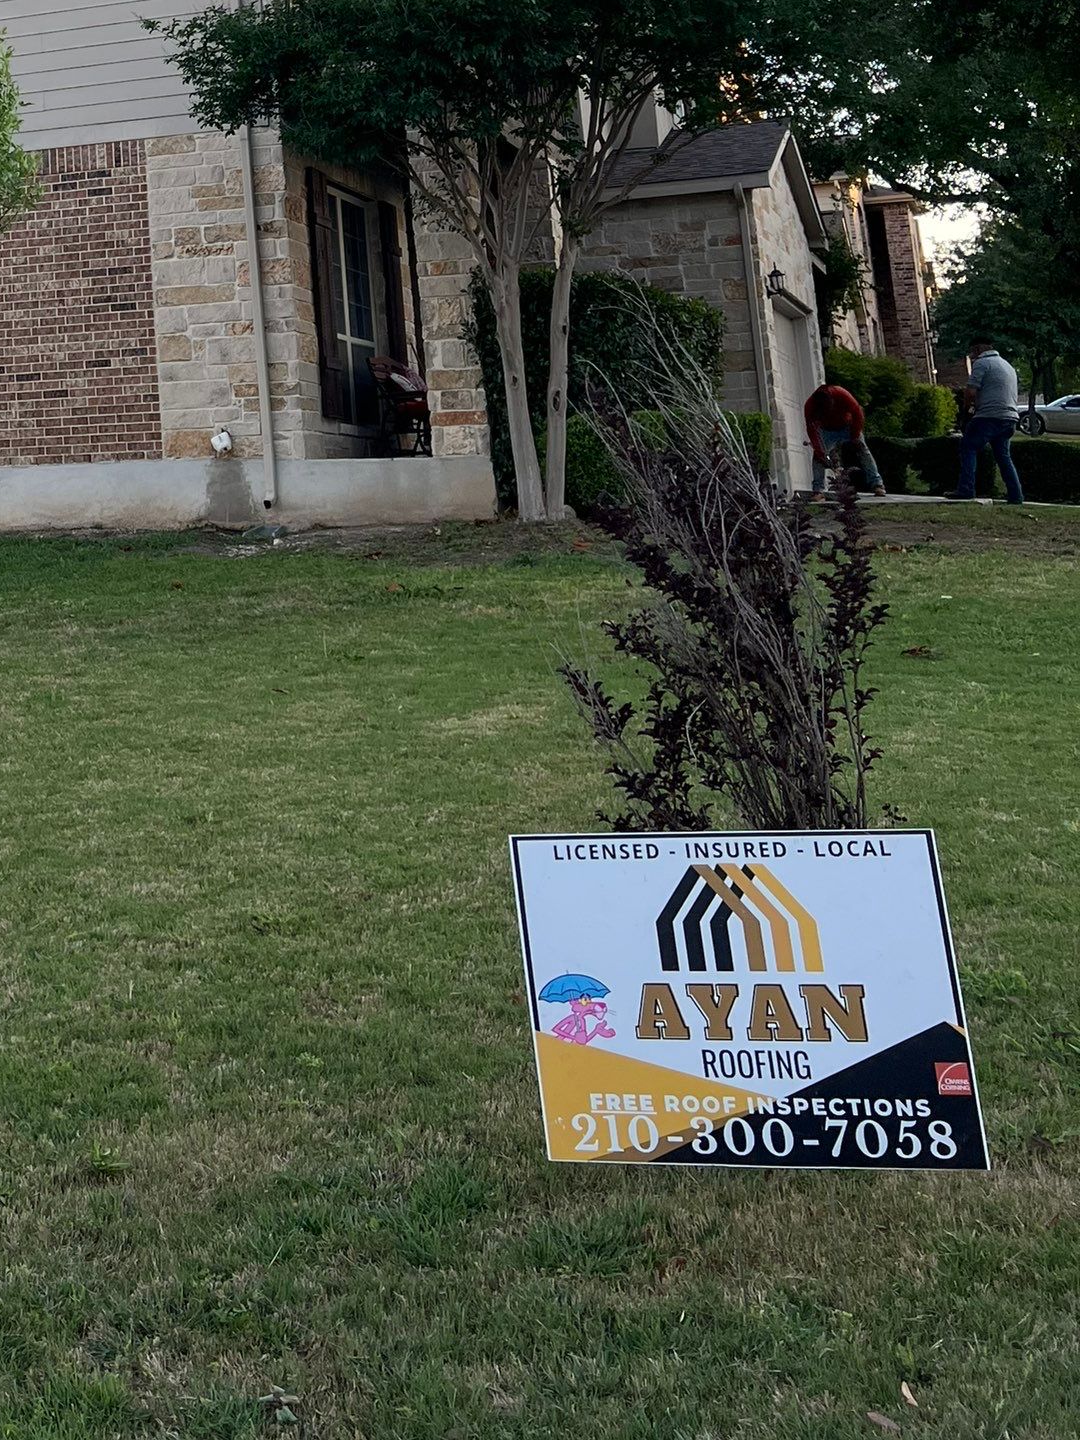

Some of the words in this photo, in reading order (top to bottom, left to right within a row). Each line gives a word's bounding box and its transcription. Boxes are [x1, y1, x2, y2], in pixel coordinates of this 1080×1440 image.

[552, 843, 659, 861] LICENSED
[684, 841, 787, 859] INSURED
[813, 839, 892, 858] LOCAL
[635, 983, 869, 1043] AYAN
[701, 1049, 812, 1080] ROOFING
[589, 1092, 655, 1111] FREE
[664, 1095, 736, 1113] ROOF
[746, 1096, 931, 1117] INSPECTIONS
[571, 1113, 957, 1159] 210-300-7058
